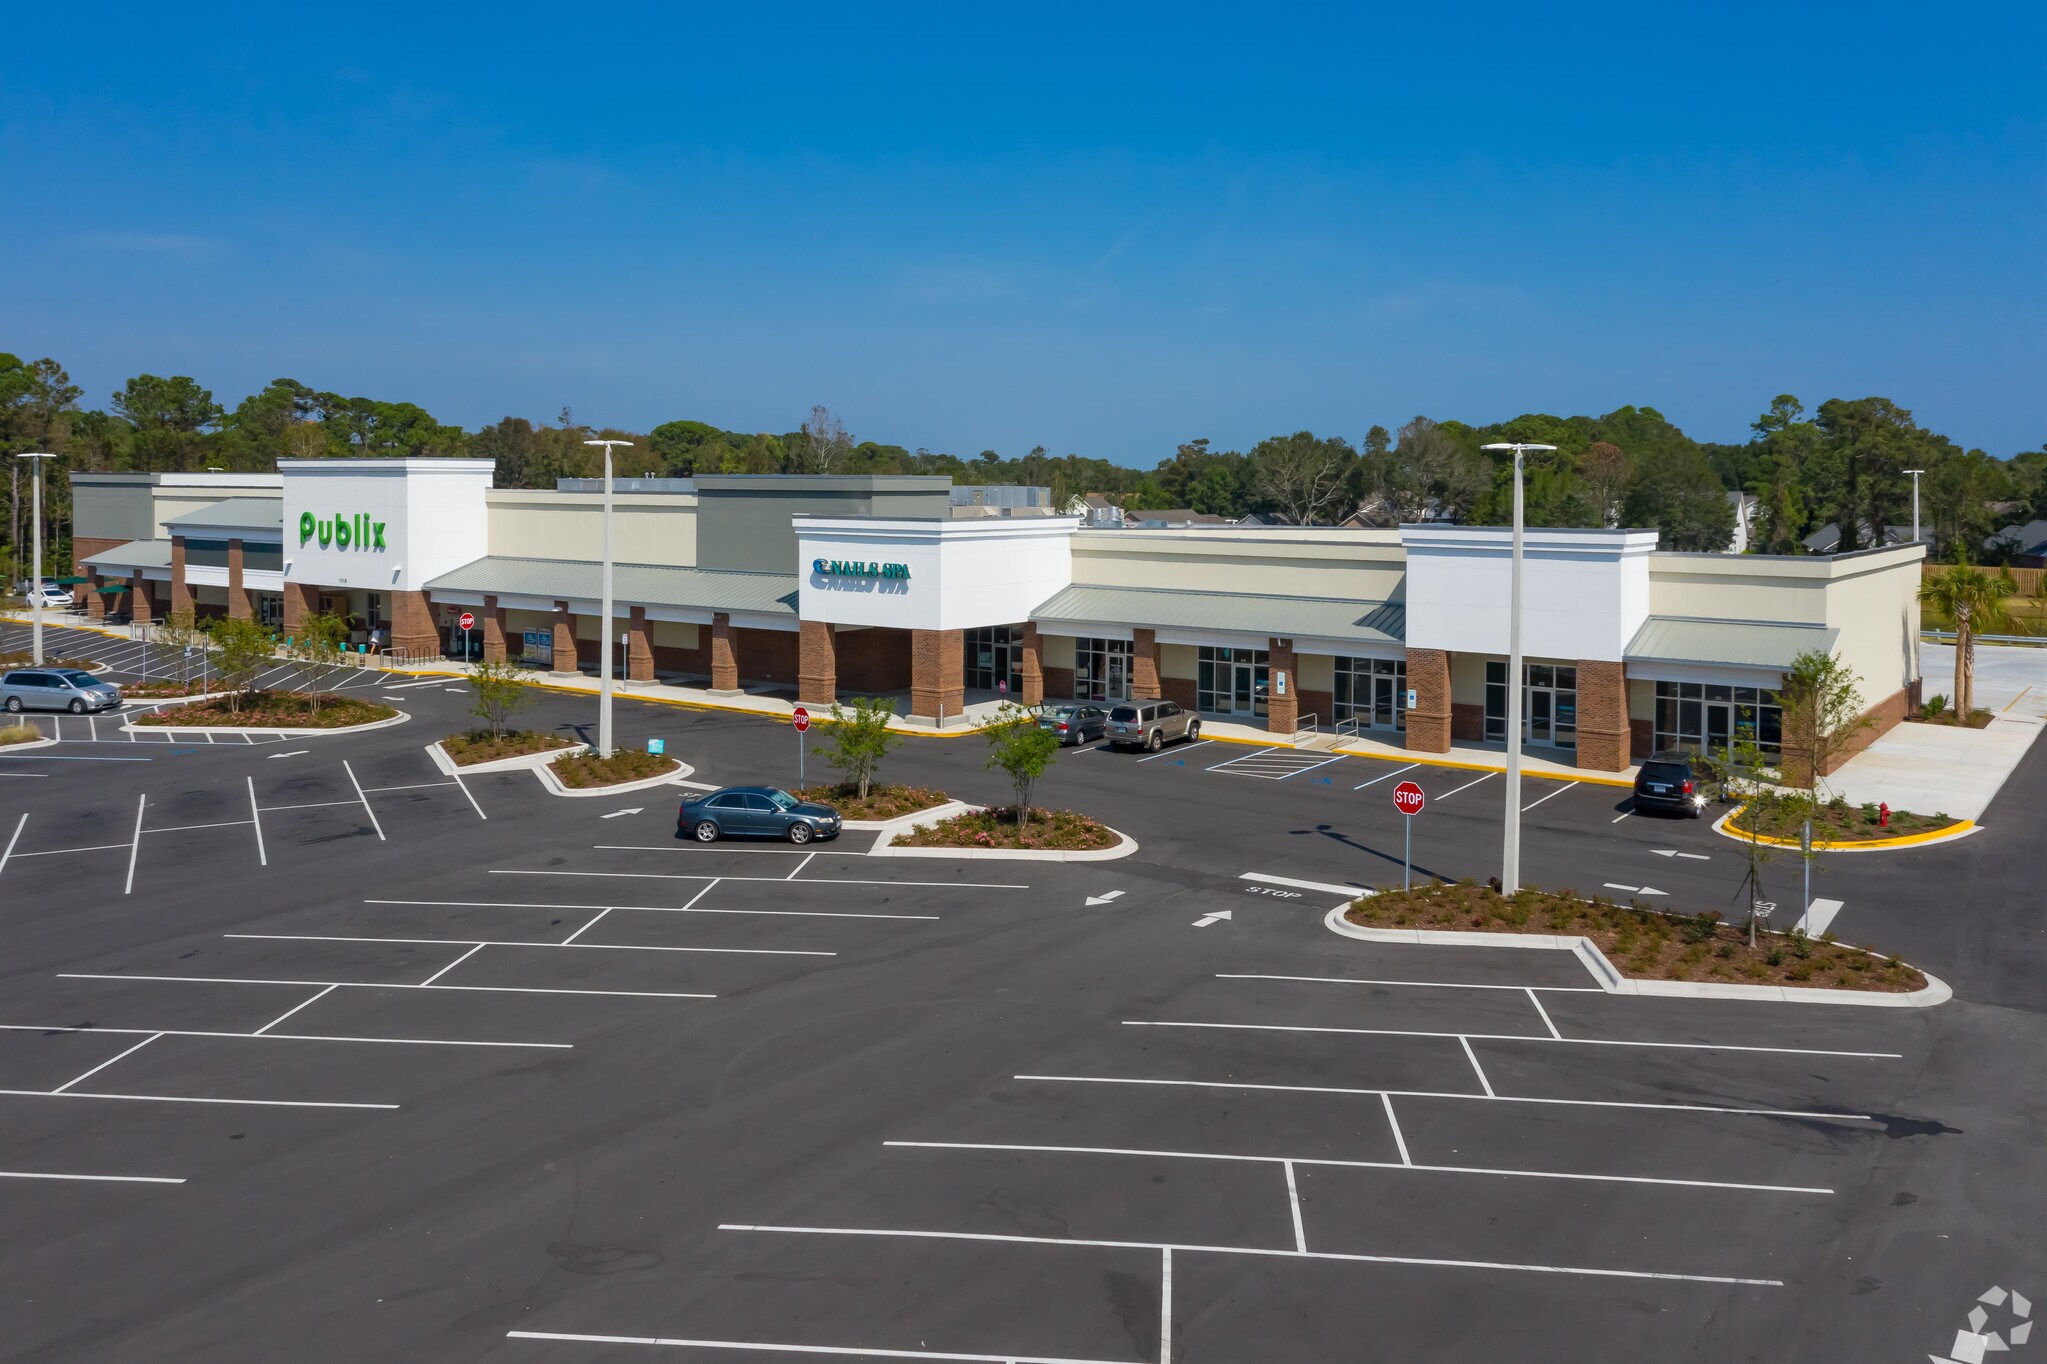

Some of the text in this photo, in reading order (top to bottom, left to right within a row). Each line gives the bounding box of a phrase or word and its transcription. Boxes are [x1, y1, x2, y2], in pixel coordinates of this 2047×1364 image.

[300, 512, 386, 548] Publix
[830, 560, 911, 580] NAILS SPA
[461, 617, 474, 625] STOP
[794, 713, 809, 725] STOP
[1396, 791, 1422, 805] STOP
[1245, 886, 1302, 898] STOP
